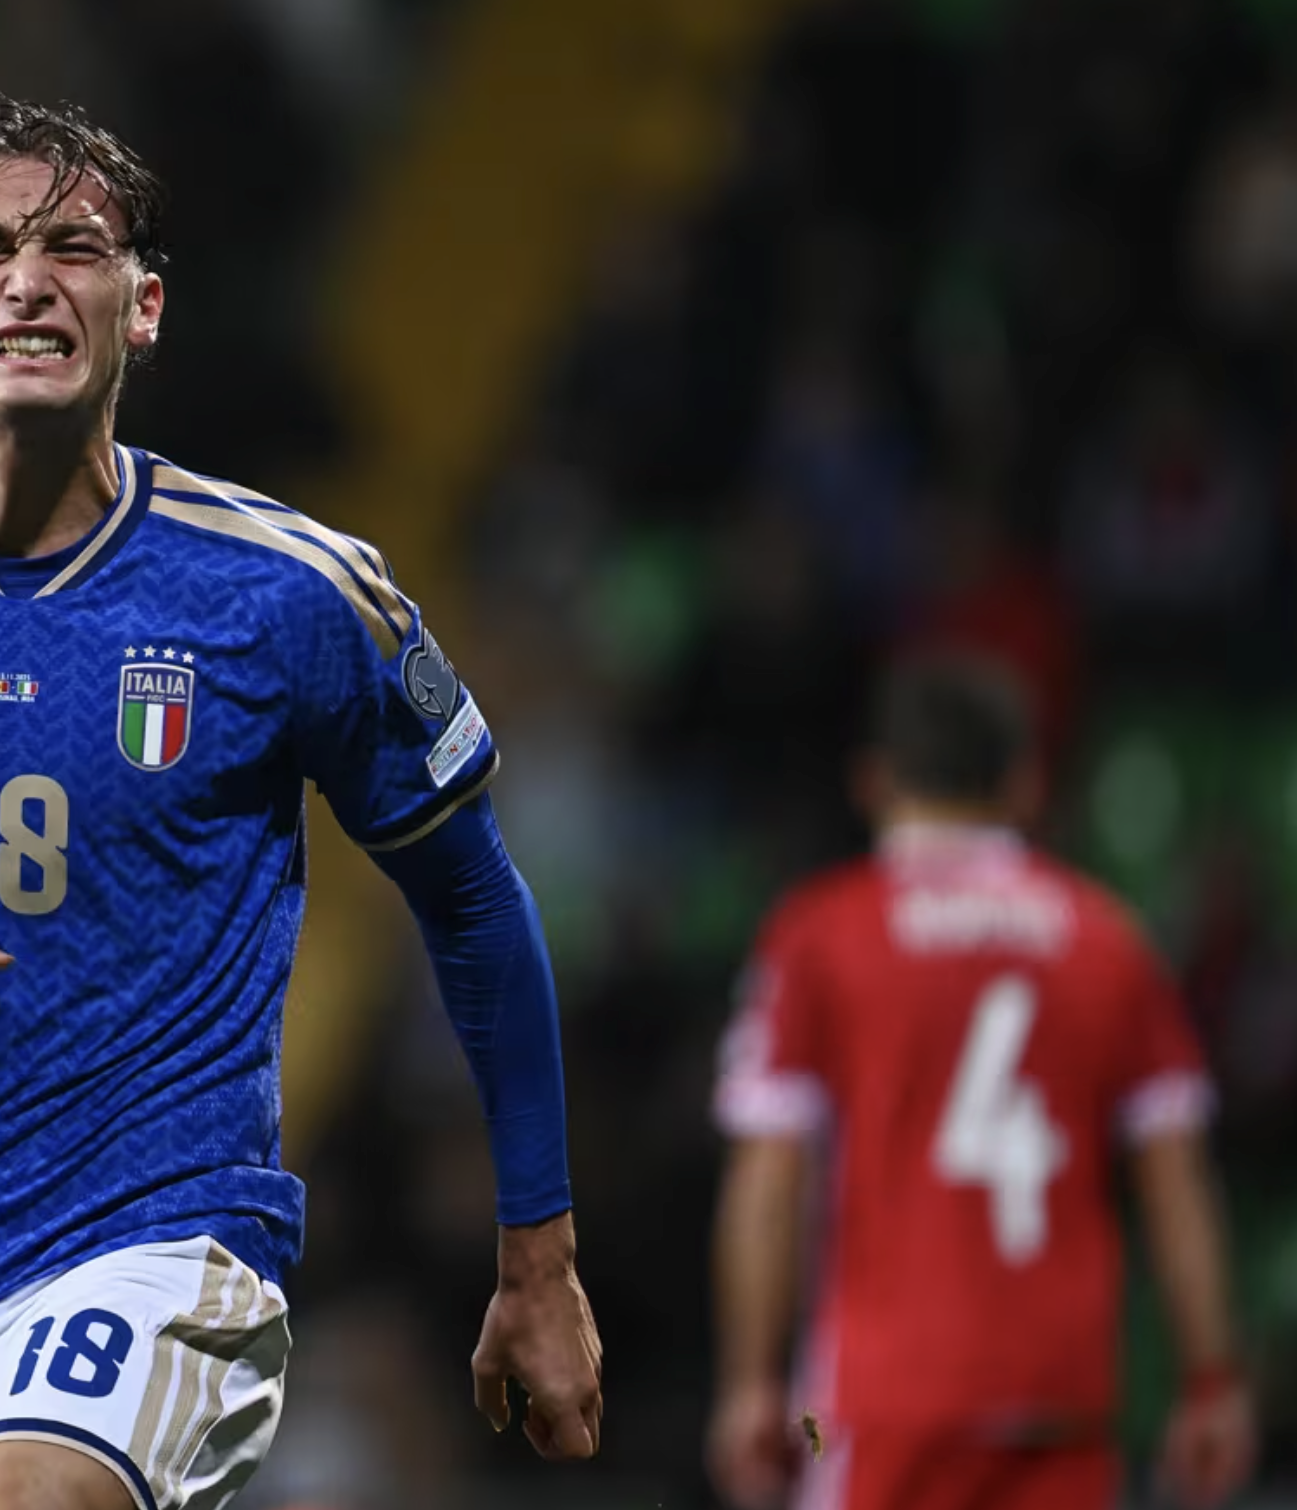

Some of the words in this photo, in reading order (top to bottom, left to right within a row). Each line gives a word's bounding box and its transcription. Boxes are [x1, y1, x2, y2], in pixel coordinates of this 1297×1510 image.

[125, 672, 186, 695] ITALIA
[933, 972, 1069, 1264] 4
[9, 1308, 134, 1398] 18
